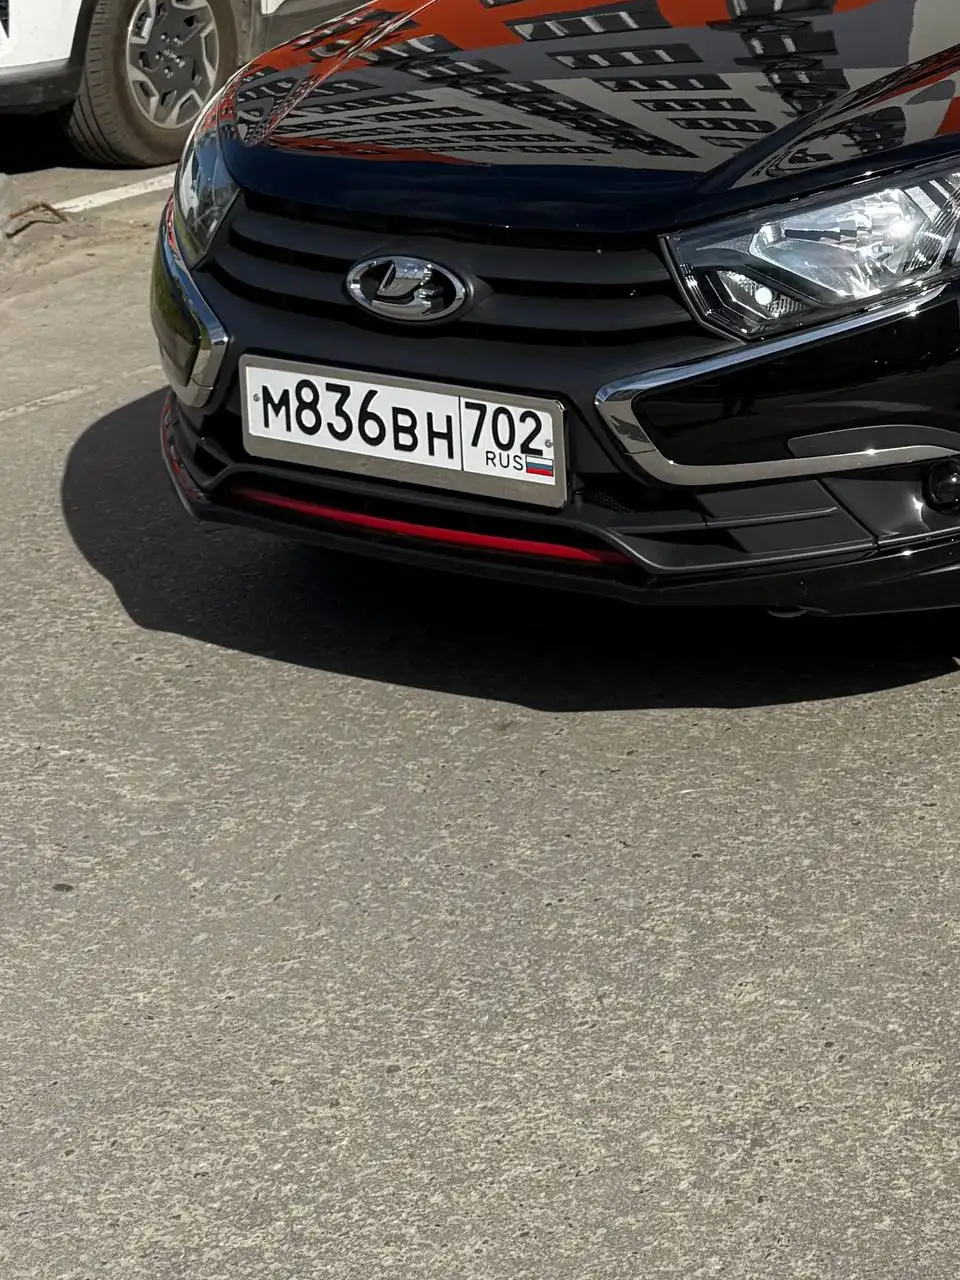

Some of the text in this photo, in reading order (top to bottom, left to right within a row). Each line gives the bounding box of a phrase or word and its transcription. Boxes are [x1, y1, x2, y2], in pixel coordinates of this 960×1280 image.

[261, 379, 544, 460] М836ВН 702
[485, 450, 524, 471] RUS
